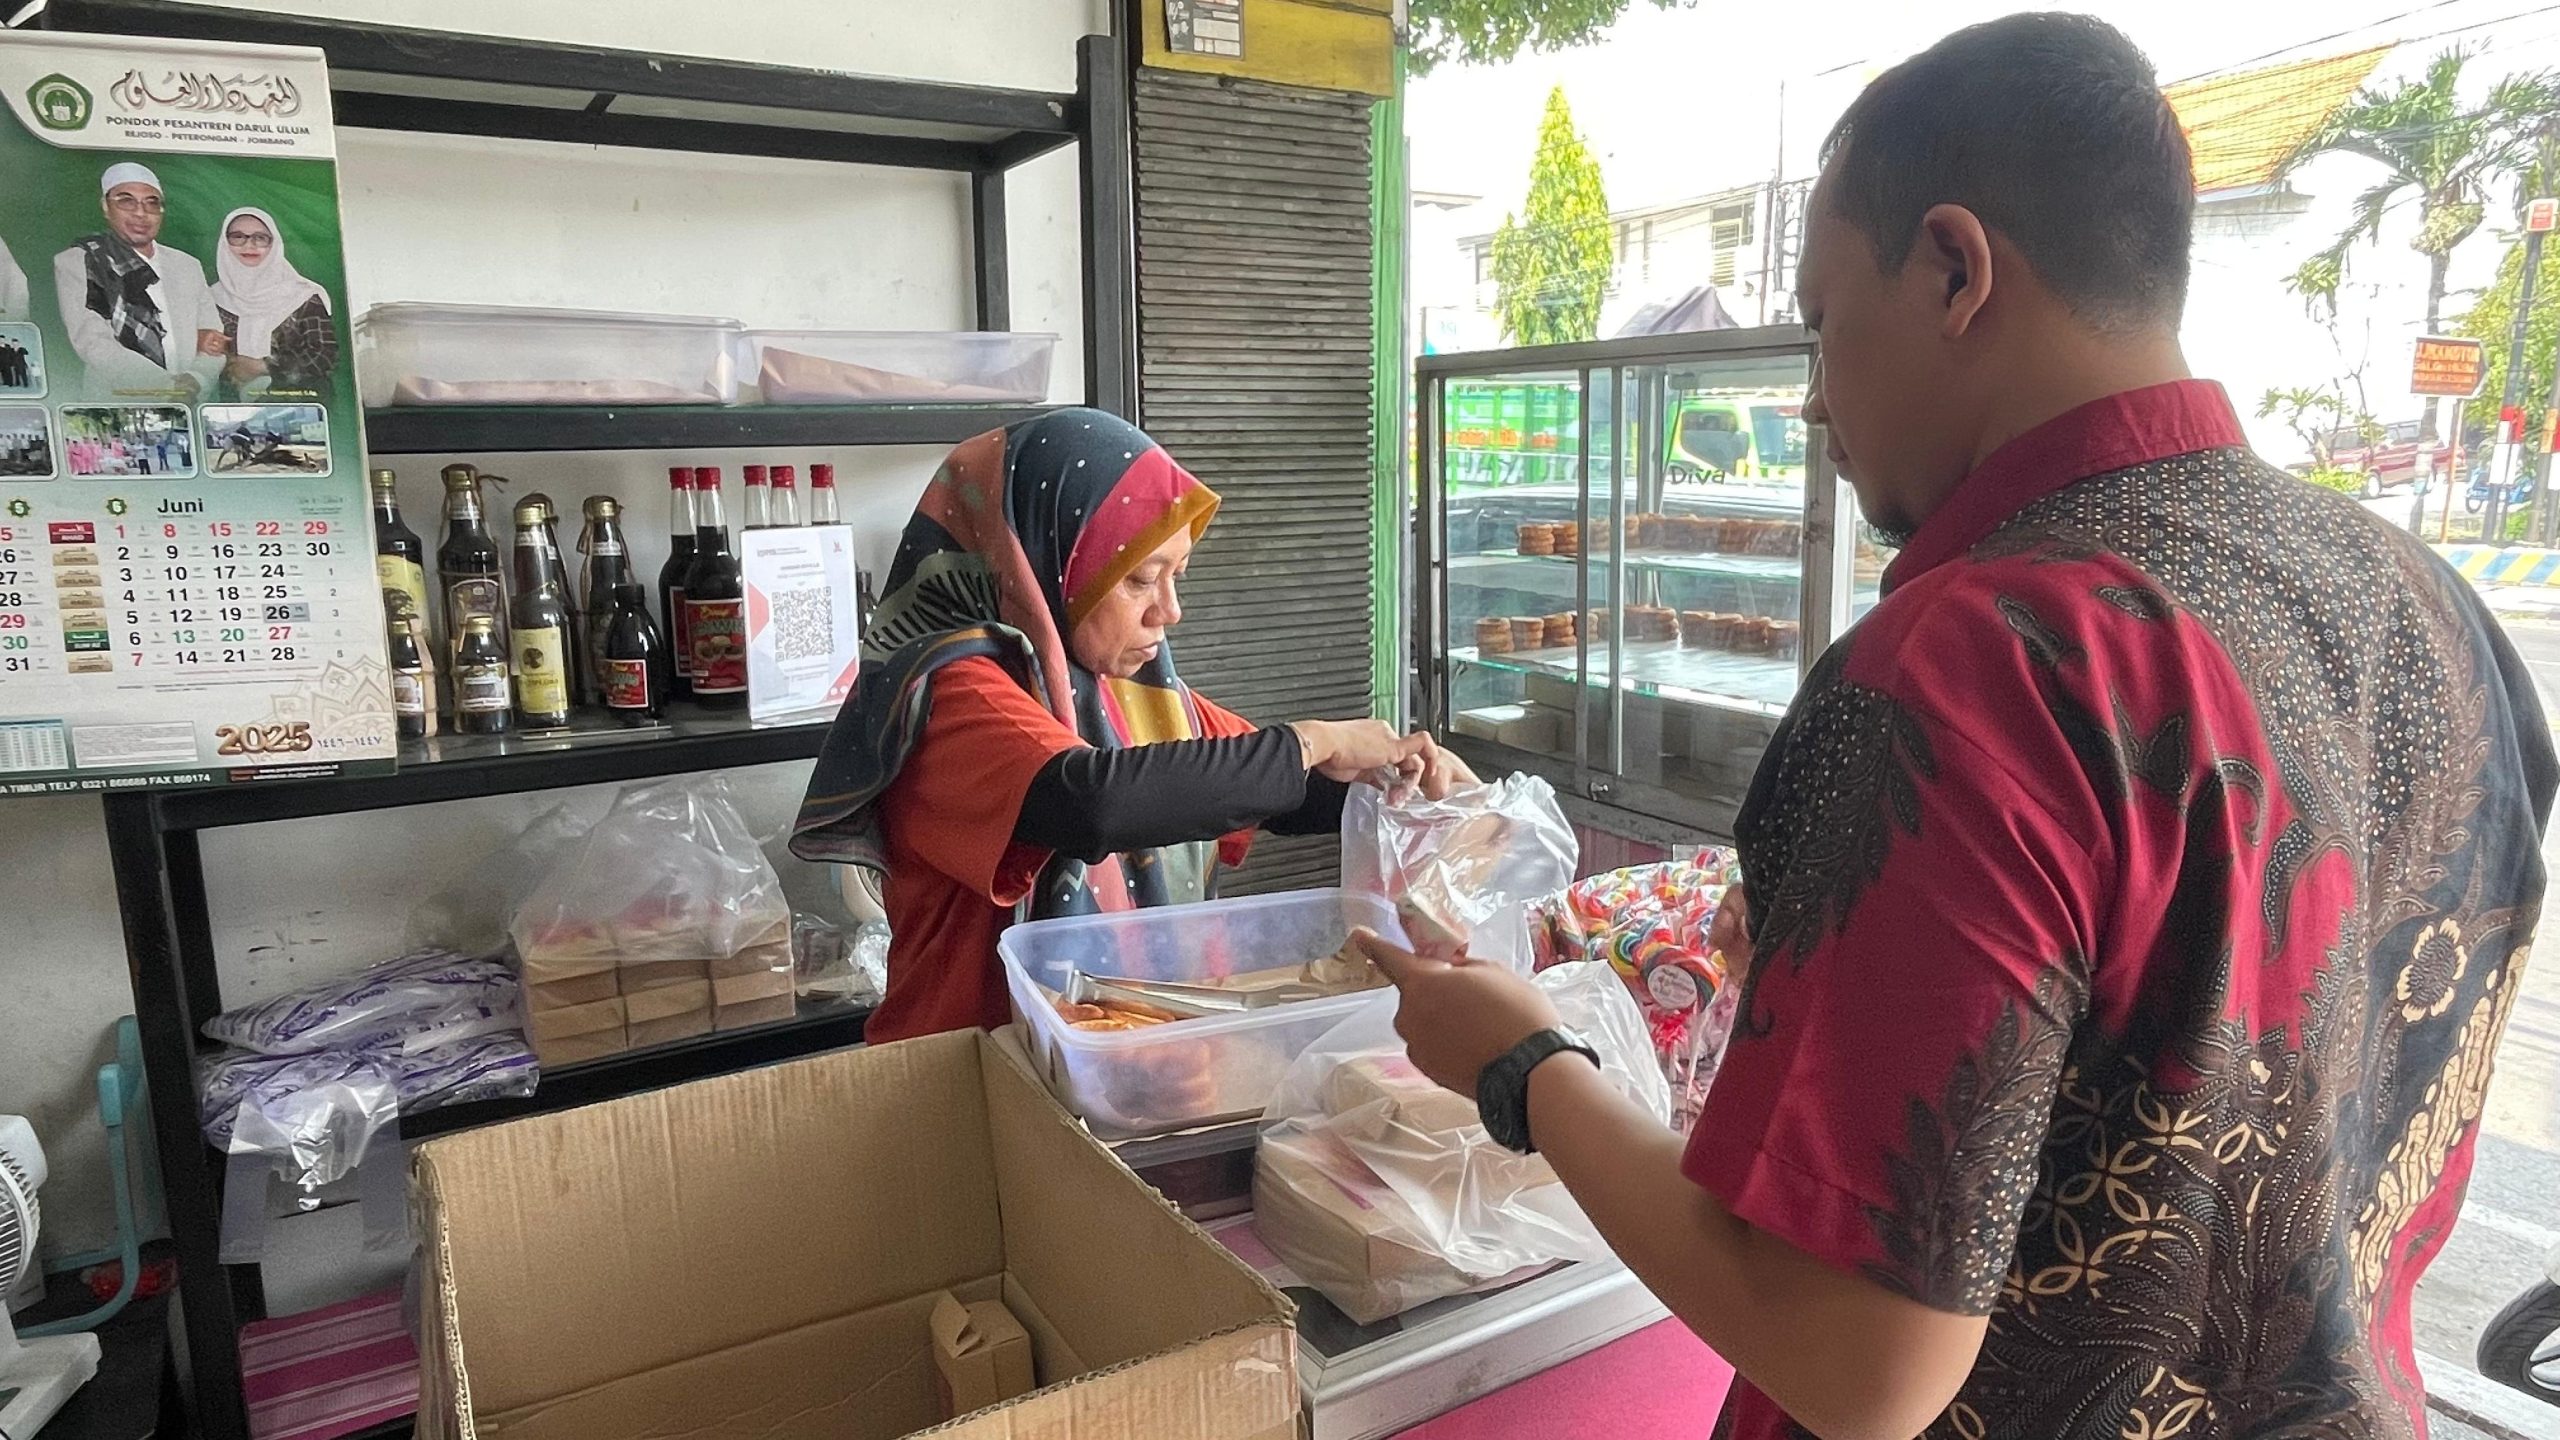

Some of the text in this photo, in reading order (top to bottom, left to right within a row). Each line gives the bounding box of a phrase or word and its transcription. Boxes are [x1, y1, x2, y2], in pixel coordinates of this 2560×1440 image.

[106, 115, 310, 135] PONDOK PESANTREN DARUL ULUM
[125, 130, 295, 146] REJOSO PETERONGAN JOMBANG
[1670, 465, 1726, 485] Diva
[157, 498, 204, 513] Juni
[115, 520, 328, 539] 1 8 15 22 29
[0, 549, 16, 563] 6
[118, 542, 330, 560] 2 9 16 23 30
[120, 567, 133, 582] 3
[164, 566, 187, 580] 10
[213, 565, 236, 579] 17
[261, 564, 285, 578] 24
[123, 589, 135, 603] 4
[166, 588, 188, 602] 11
[216, 586, 240, 600] 18
[263, 585, 287, 599] 25
[0, 614, 25, 628] 29
[126, 610, 138, 624] 5
[169, 608, 193, 623] 12
[219, 607, 242, 621] 19
[266, 605, 290, 620] 26
[3, 635, 28, 650] 30
[129, 631, 141, 645] 6
[172, 629, 196, 643] 13
[220, 628, 245, 642] 20
[268, 626, 292, 640] 27
[6, 657, 30, 672] 31
[131, 653, 143, 667] 7
[175, 650, 199, 665] 14
[224, 649, 246, 663] 21
[272, 647, 295, 661] 28
[215, 721, 313, 755] 2025
[11, 783, 47, 793] TIMUR
[149, 775, 172, 785] FAX
